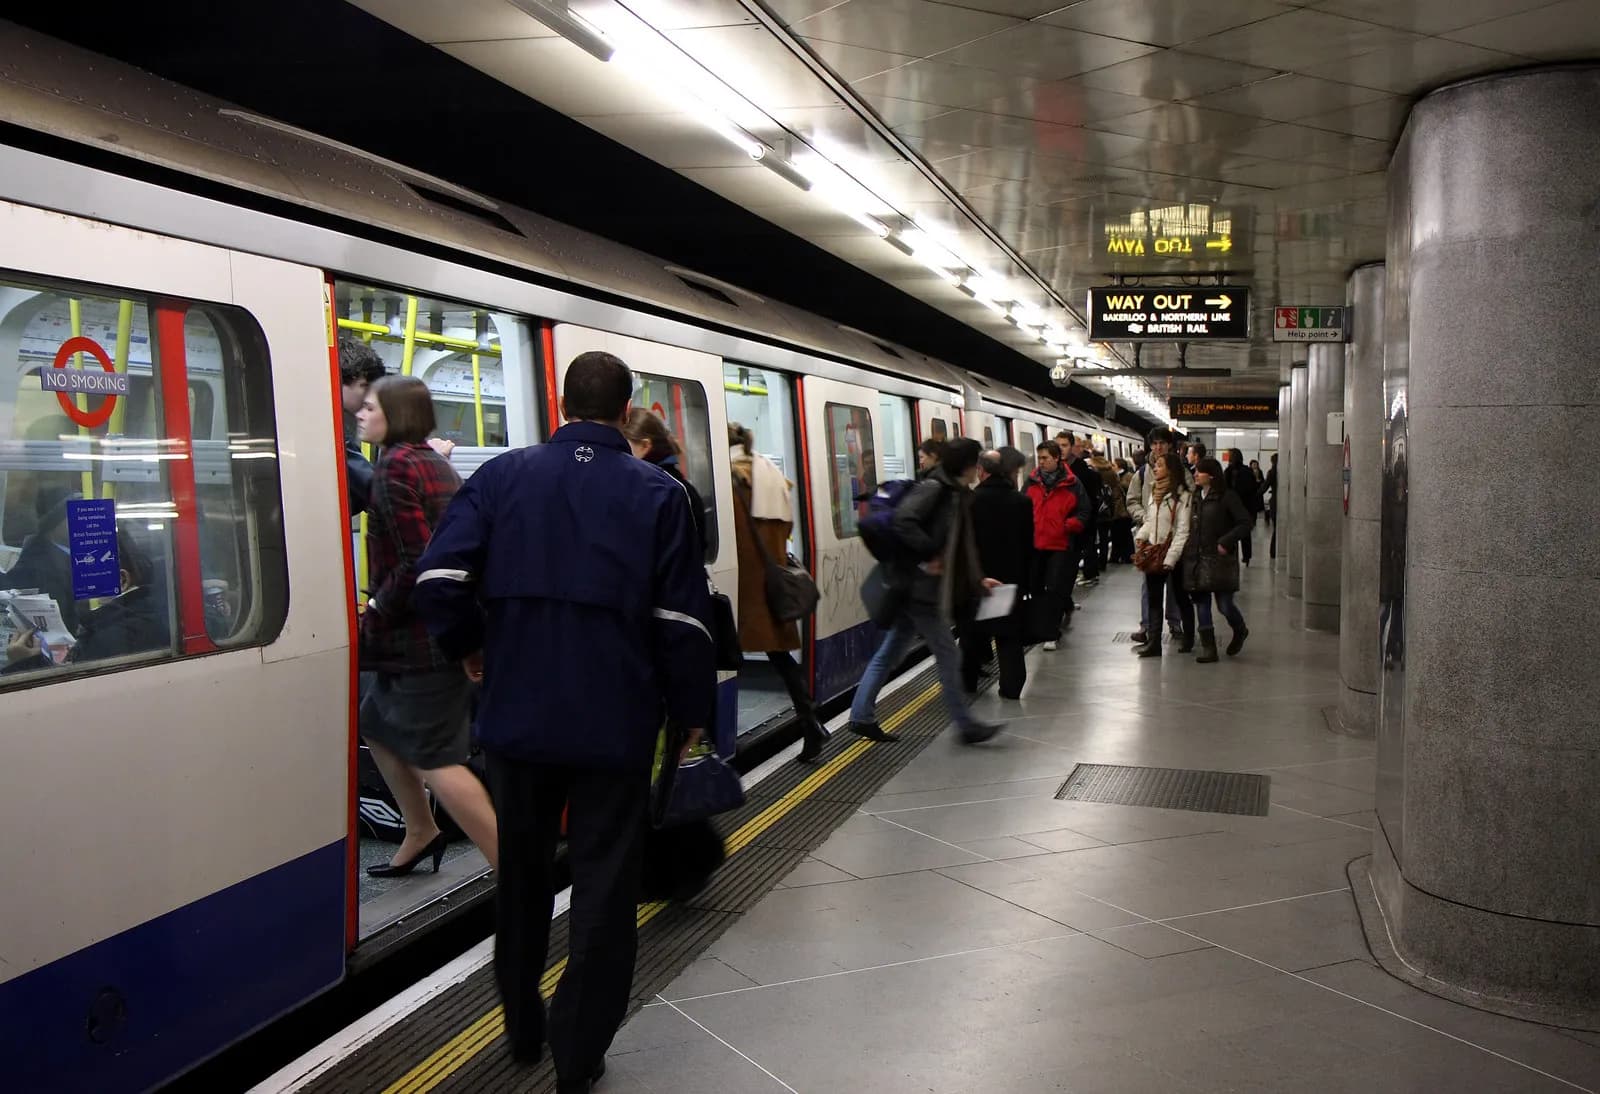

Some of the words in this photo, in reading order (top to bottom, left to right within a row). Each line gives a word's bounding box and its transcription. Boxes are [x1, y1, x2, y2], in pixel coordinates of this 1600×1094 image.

[1106, 295, 1145, 310] WAY
[1153, 295, 1193, 310] OUT
[1102, 313, 1147, 322] BAKERLOO
[1161, 313, 1208, 322] NORTHERN
[1211, 313, 1231, 322] LINE
[1147, 324, 1182, 334] BRITISH
[1186, 324, 1209, 334] RAIL
[1308, 330, 1329, 339] point
[46, 372, 67, 387] NO
[71, 374, 126, 391] SMOKING
